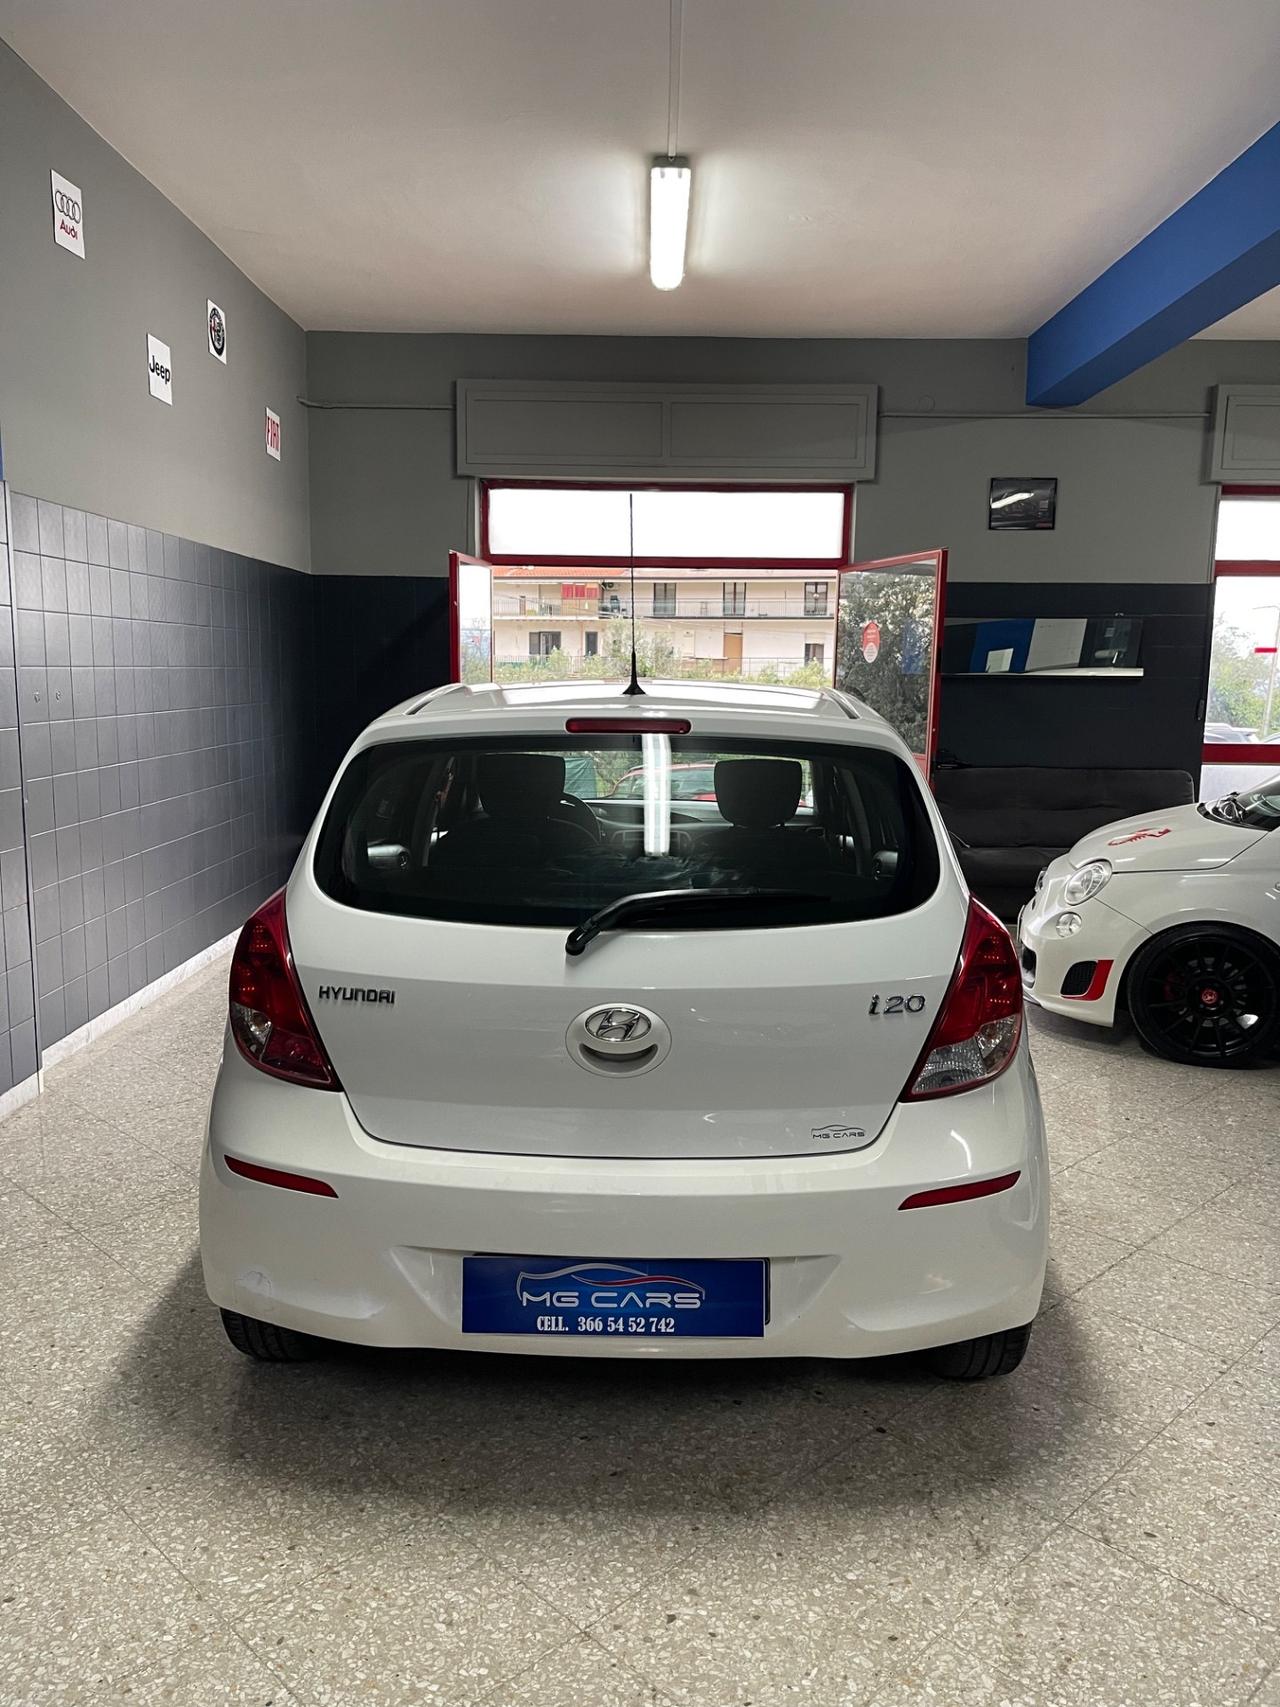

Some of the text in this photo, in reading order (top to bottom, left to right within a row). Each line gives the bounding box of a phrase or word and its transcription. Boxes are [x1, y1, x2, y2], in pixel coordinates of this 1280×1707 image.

[60, 219, 78, 240] Audi
[149, 355, 171, 385] Jeep
[266, 416, 280, 452] FIAT
[319, 986, 395, 1004] HYUNDAI
[868, 993, 926, 1015] i20
[833, 1131, 865, 1139] CARS
[522, 1291, 702, 1309] MG CARS
[536, 1315, 675, 1333] CELL. 366 54 52 742
